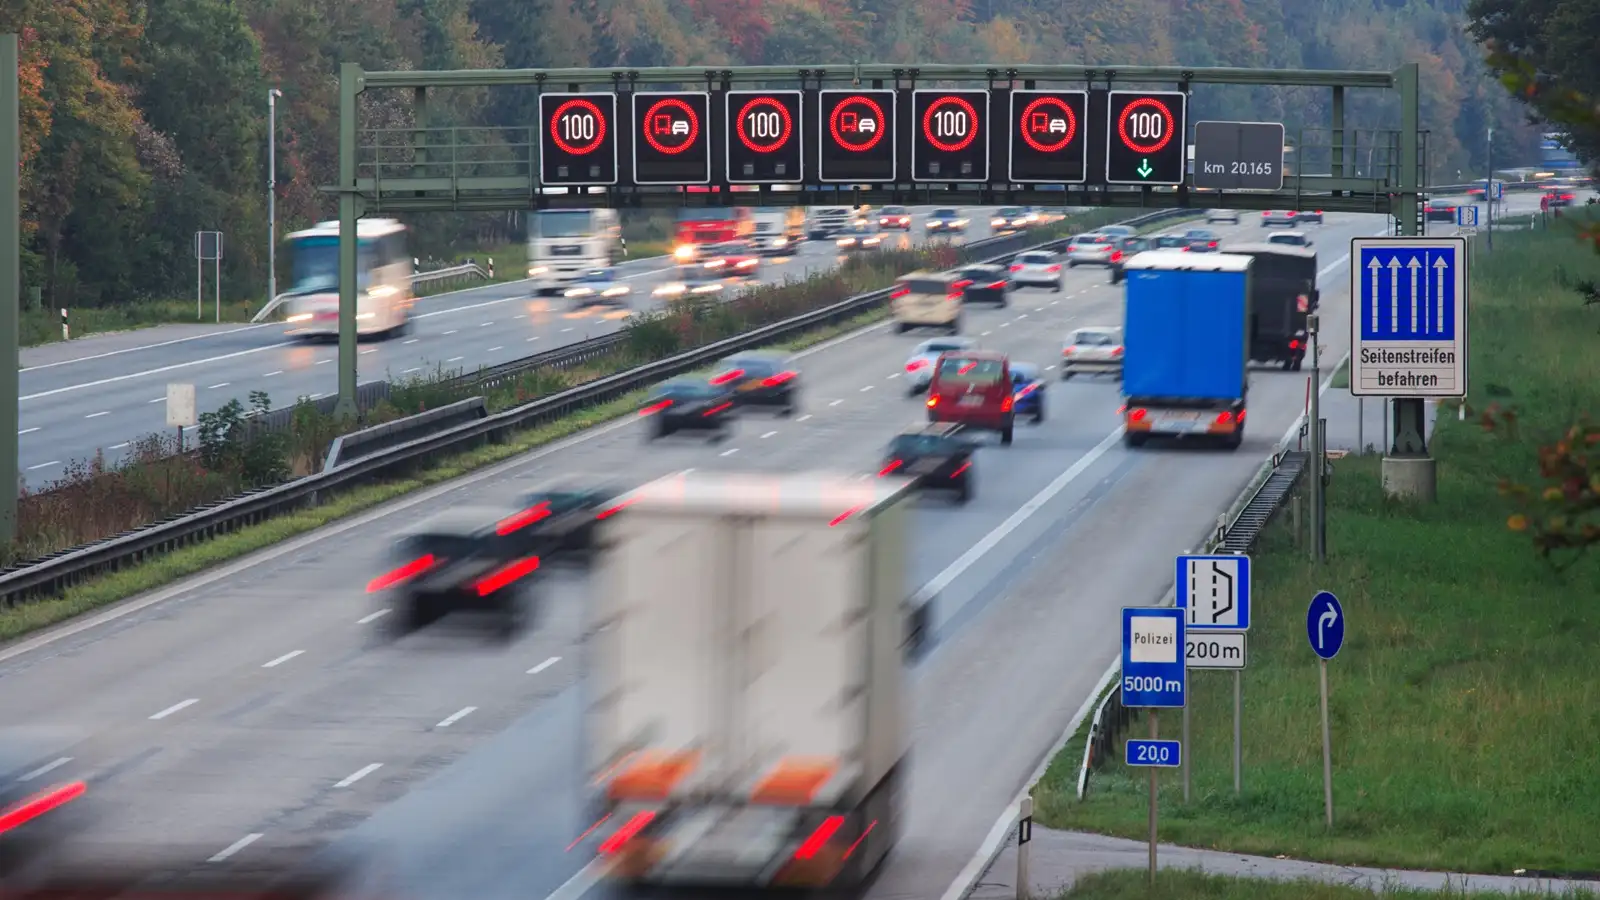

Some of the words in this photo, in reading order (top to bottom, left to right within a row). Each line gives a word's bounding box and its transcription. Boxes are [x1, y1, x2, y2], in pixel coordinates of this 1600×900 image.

[562, 114, 594, 140] 100
[747, 112, 780, 138] 100
[934, 111, 966, 137] 100
[1129, 113, 1161, 138] 100
[1204, 161, 1225, 174] km
[1361, 348, 1455, 364] Seitenstreifen
[1378, 370, 1438, 386] befahren
[1134, 632, 1173, 645] Polizei
